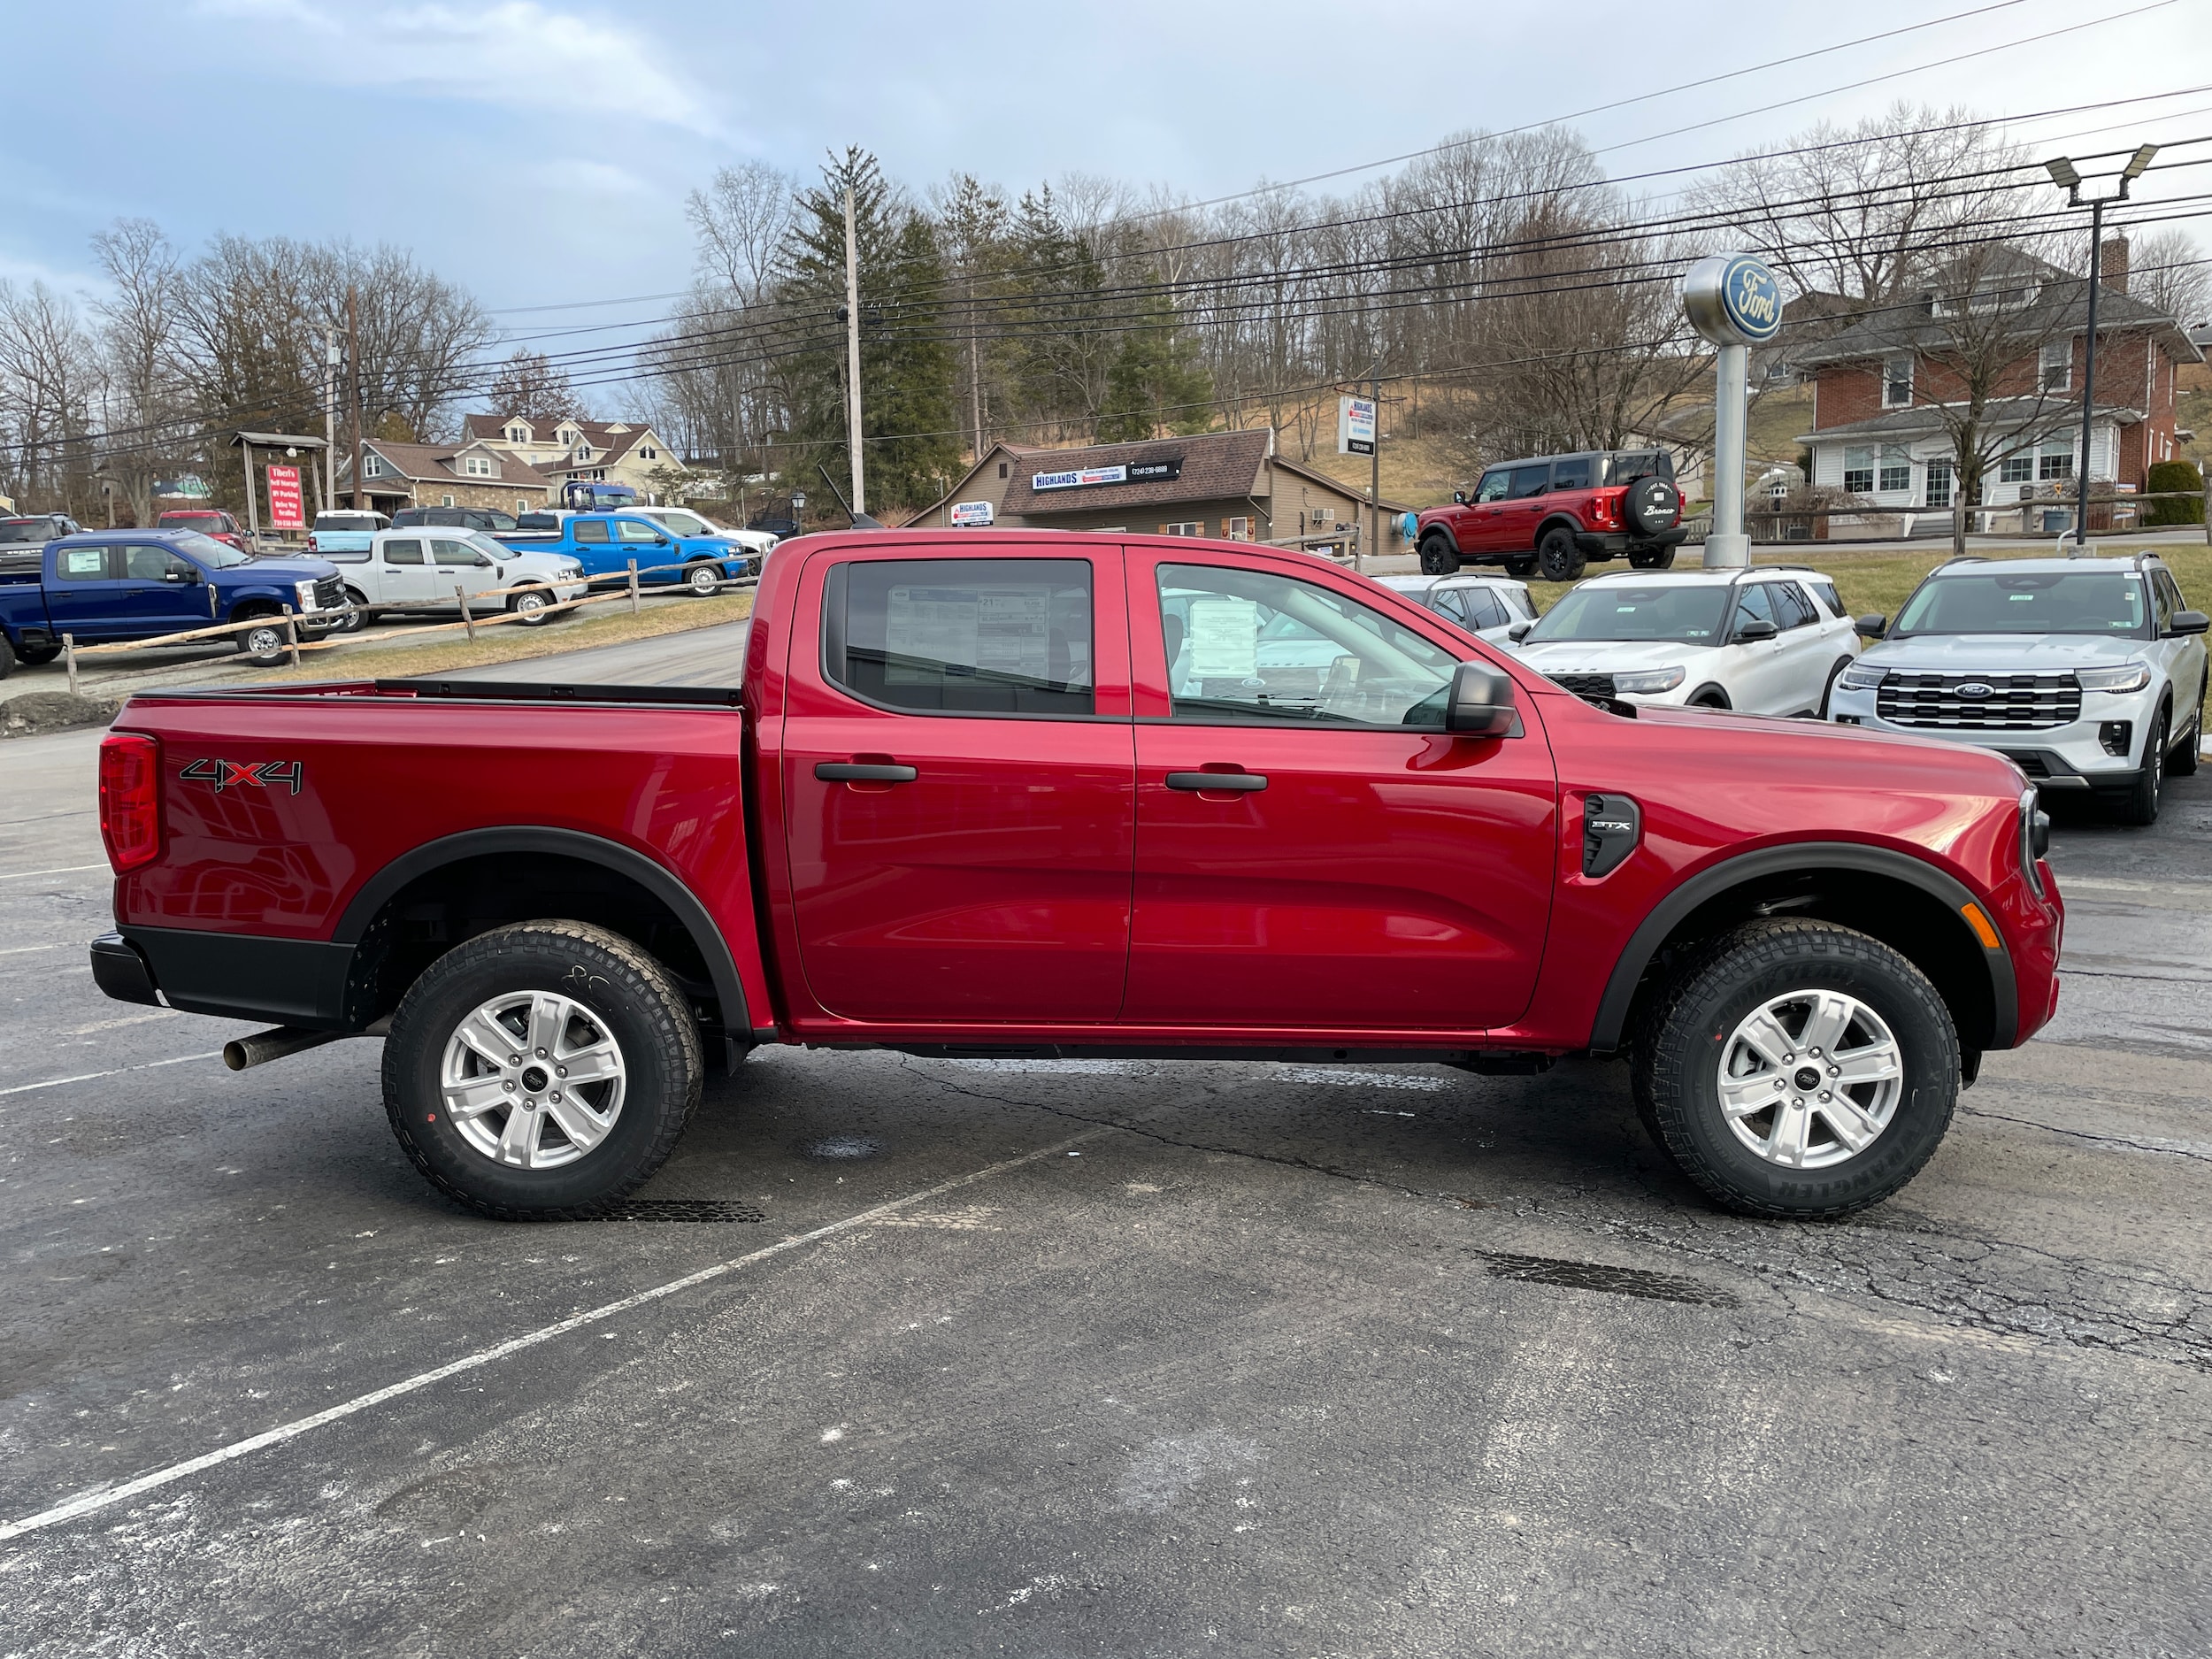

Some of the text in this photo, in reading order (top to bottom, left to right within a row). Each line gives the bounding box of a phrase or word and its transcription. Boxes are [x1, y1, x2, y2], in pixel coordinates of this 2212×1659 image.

[1739, 269, 1776, 324] Ford
[1036, 473, 1077, 487] HIGHLANDS
[959, 503, 987, 513] HIGHLANDS
[1643, 504, 1676, 517] Bronco
[1592, 821, 1631, 830] STX
